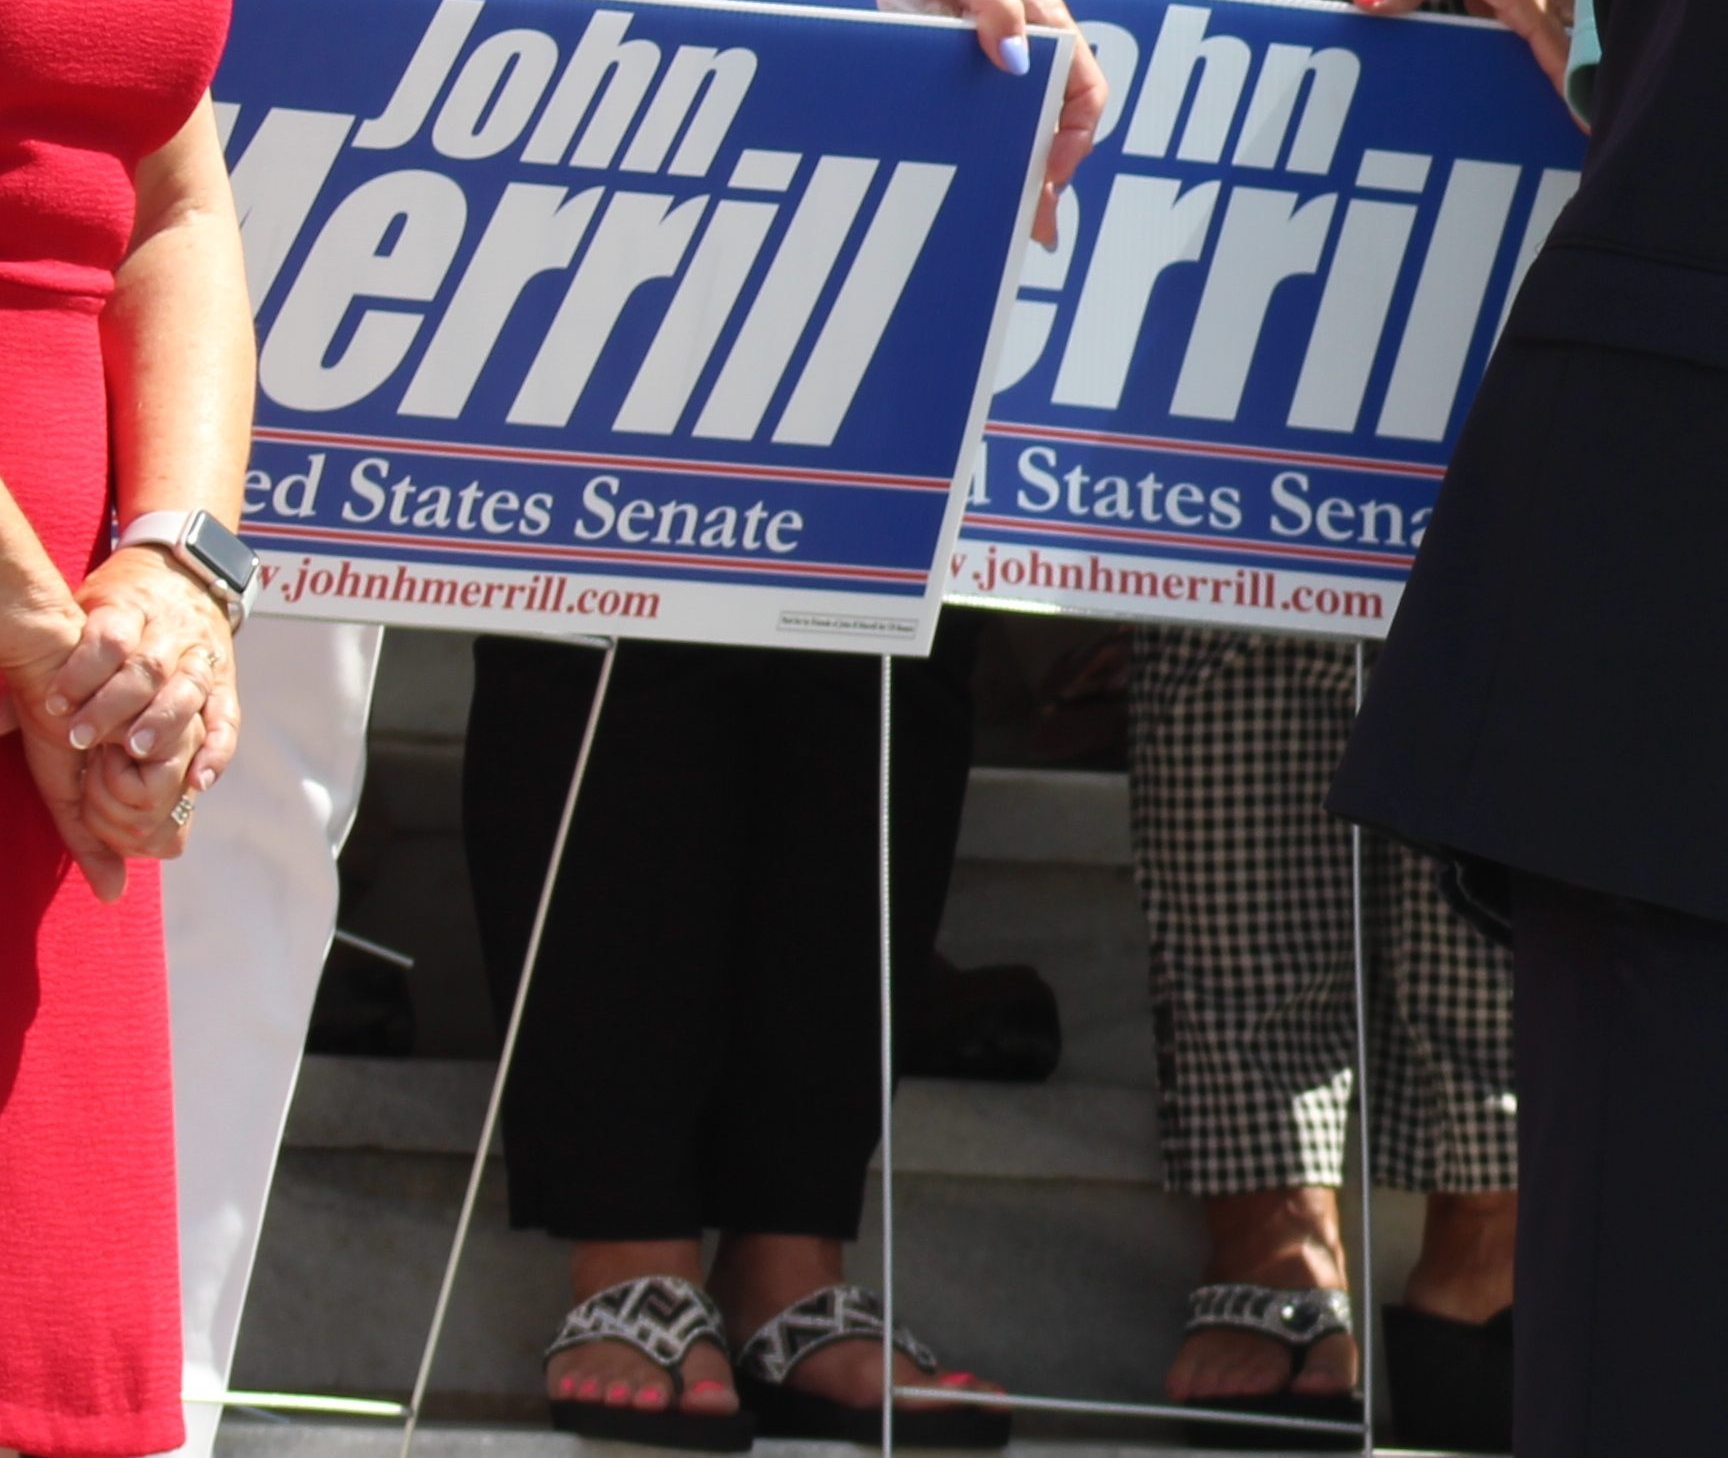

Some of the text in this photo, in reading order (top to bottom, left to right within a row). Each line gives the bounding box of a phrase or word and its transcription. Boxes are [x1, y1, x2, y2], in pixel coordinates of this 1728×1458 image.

[1076, 4, 1362, 175] ohn
[342, 456, 553, 536] States
[573, 475, 803, 554] Senate
[1017, 446, 1242, 530] States
[260, 557, 661, 620] .johnhmerrill.com
[950, 546, 1384, 619] .johnhmerrill.com
